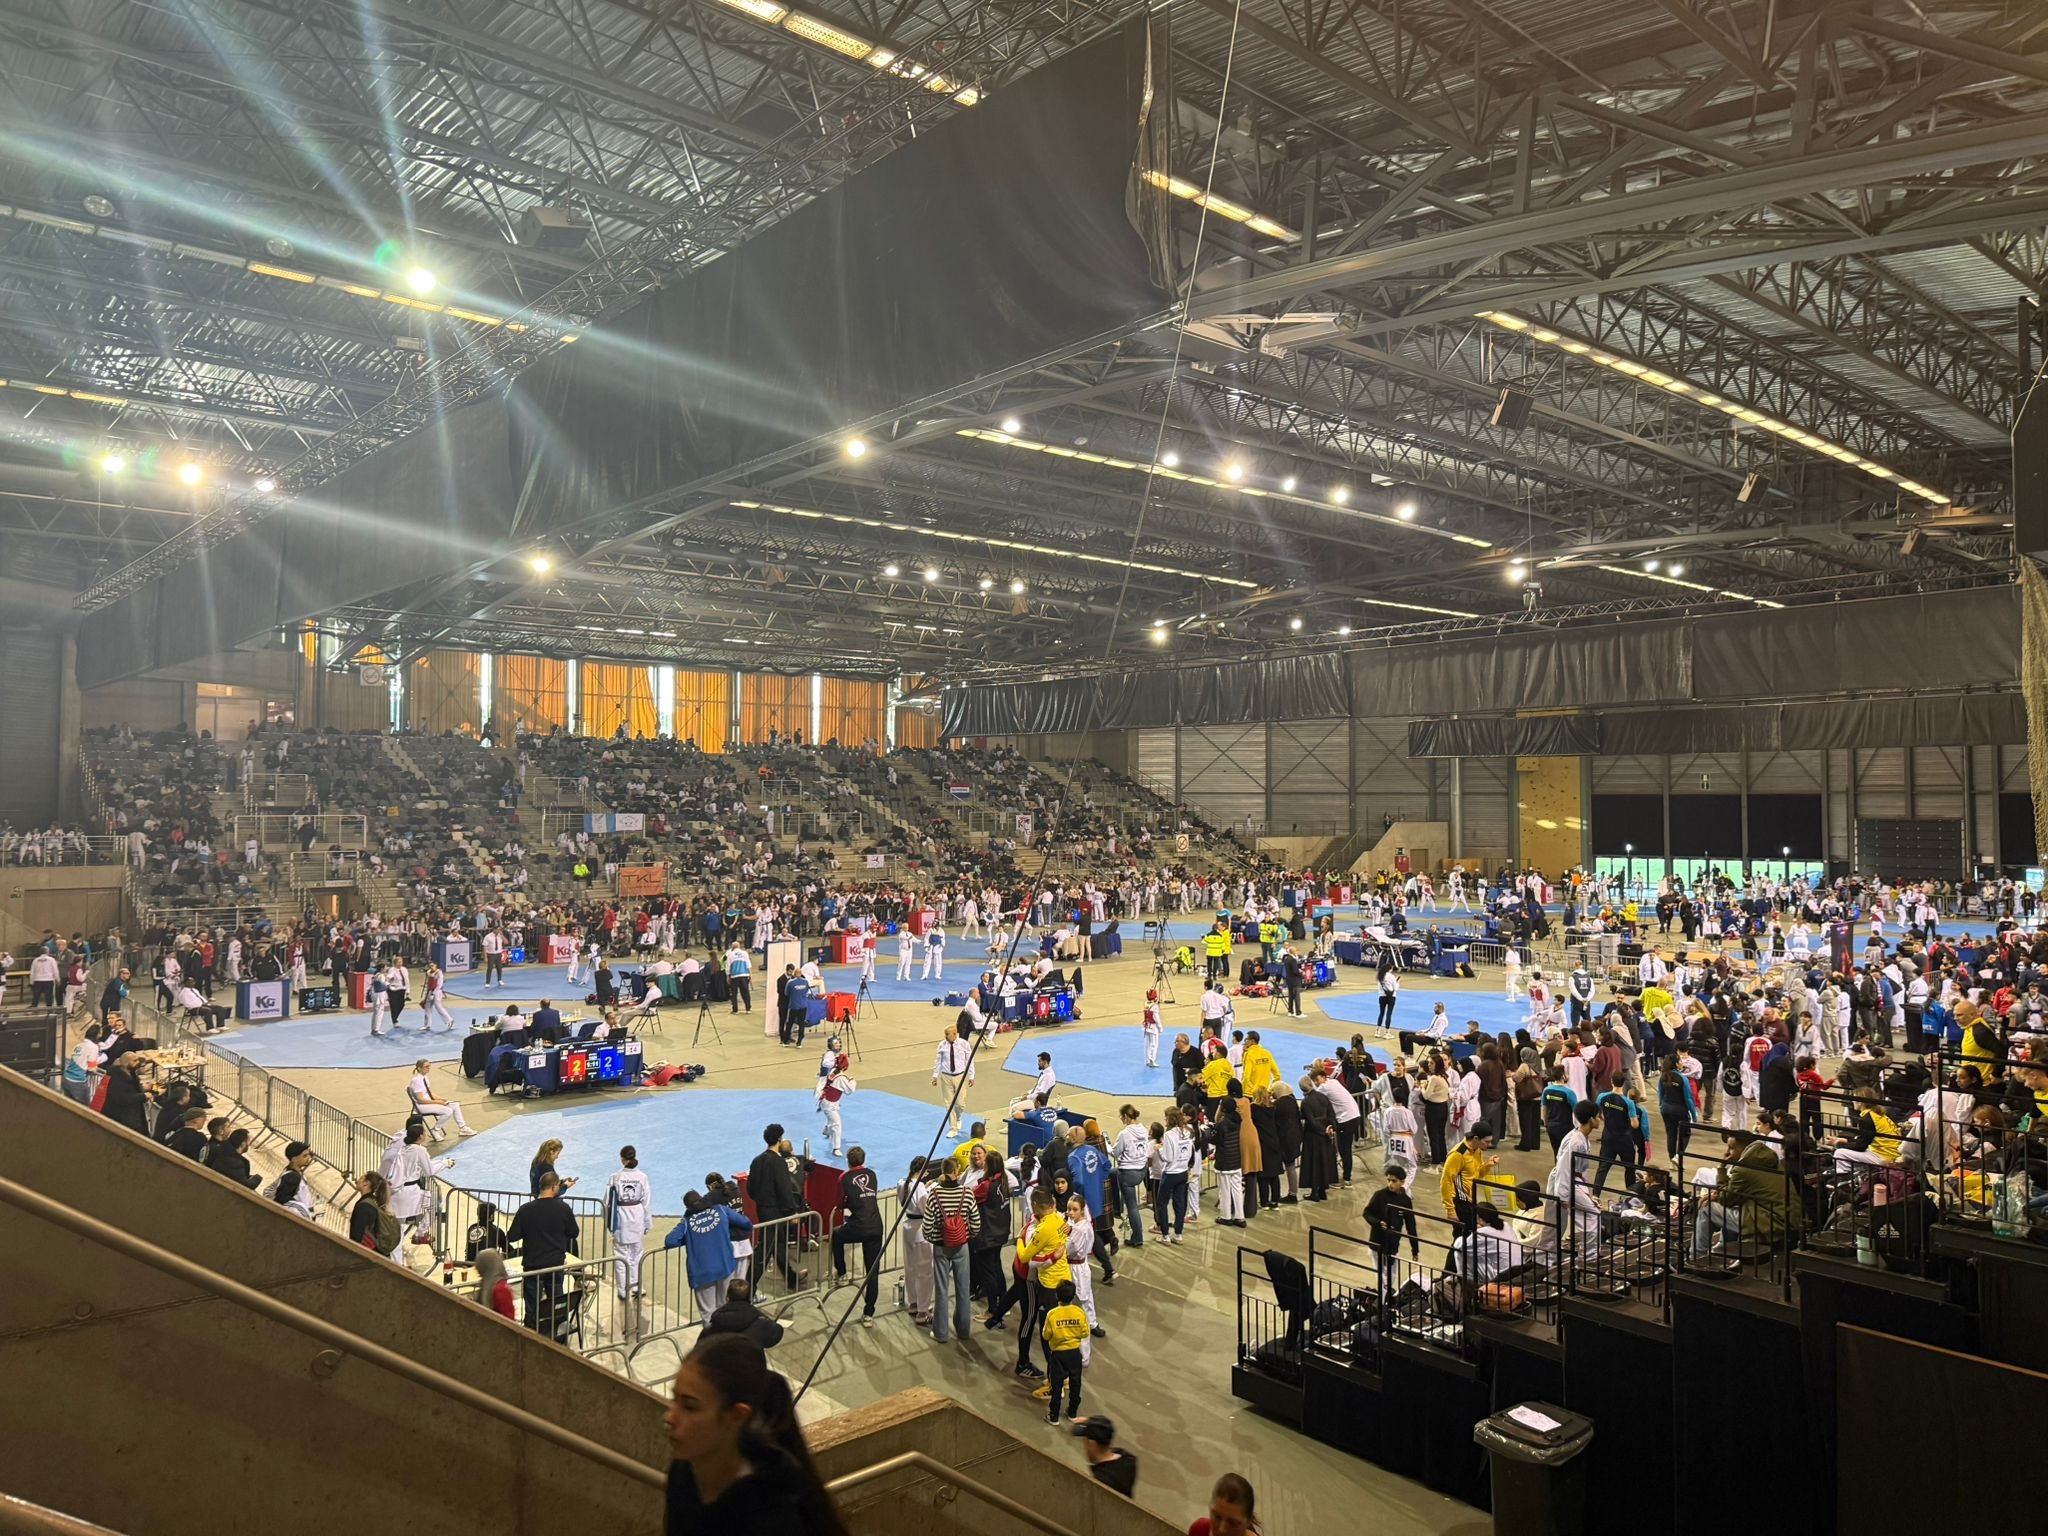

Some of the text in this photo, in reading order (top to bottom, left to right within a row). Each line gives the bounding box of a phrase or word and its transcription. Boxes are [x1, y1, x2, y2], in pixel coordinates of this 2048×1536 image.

[622, 873, 661, 884] TKL
[256, 995, 276, 1009] KG
[1041, 1002, 1046, 1011] 0
[1060, 1000, 1065, 1009] 0
[572, 1060, 581, 1072] 2
[604, 1056, 612, 1068] 2
[1390, 1139, 1406, 1153] BEL
